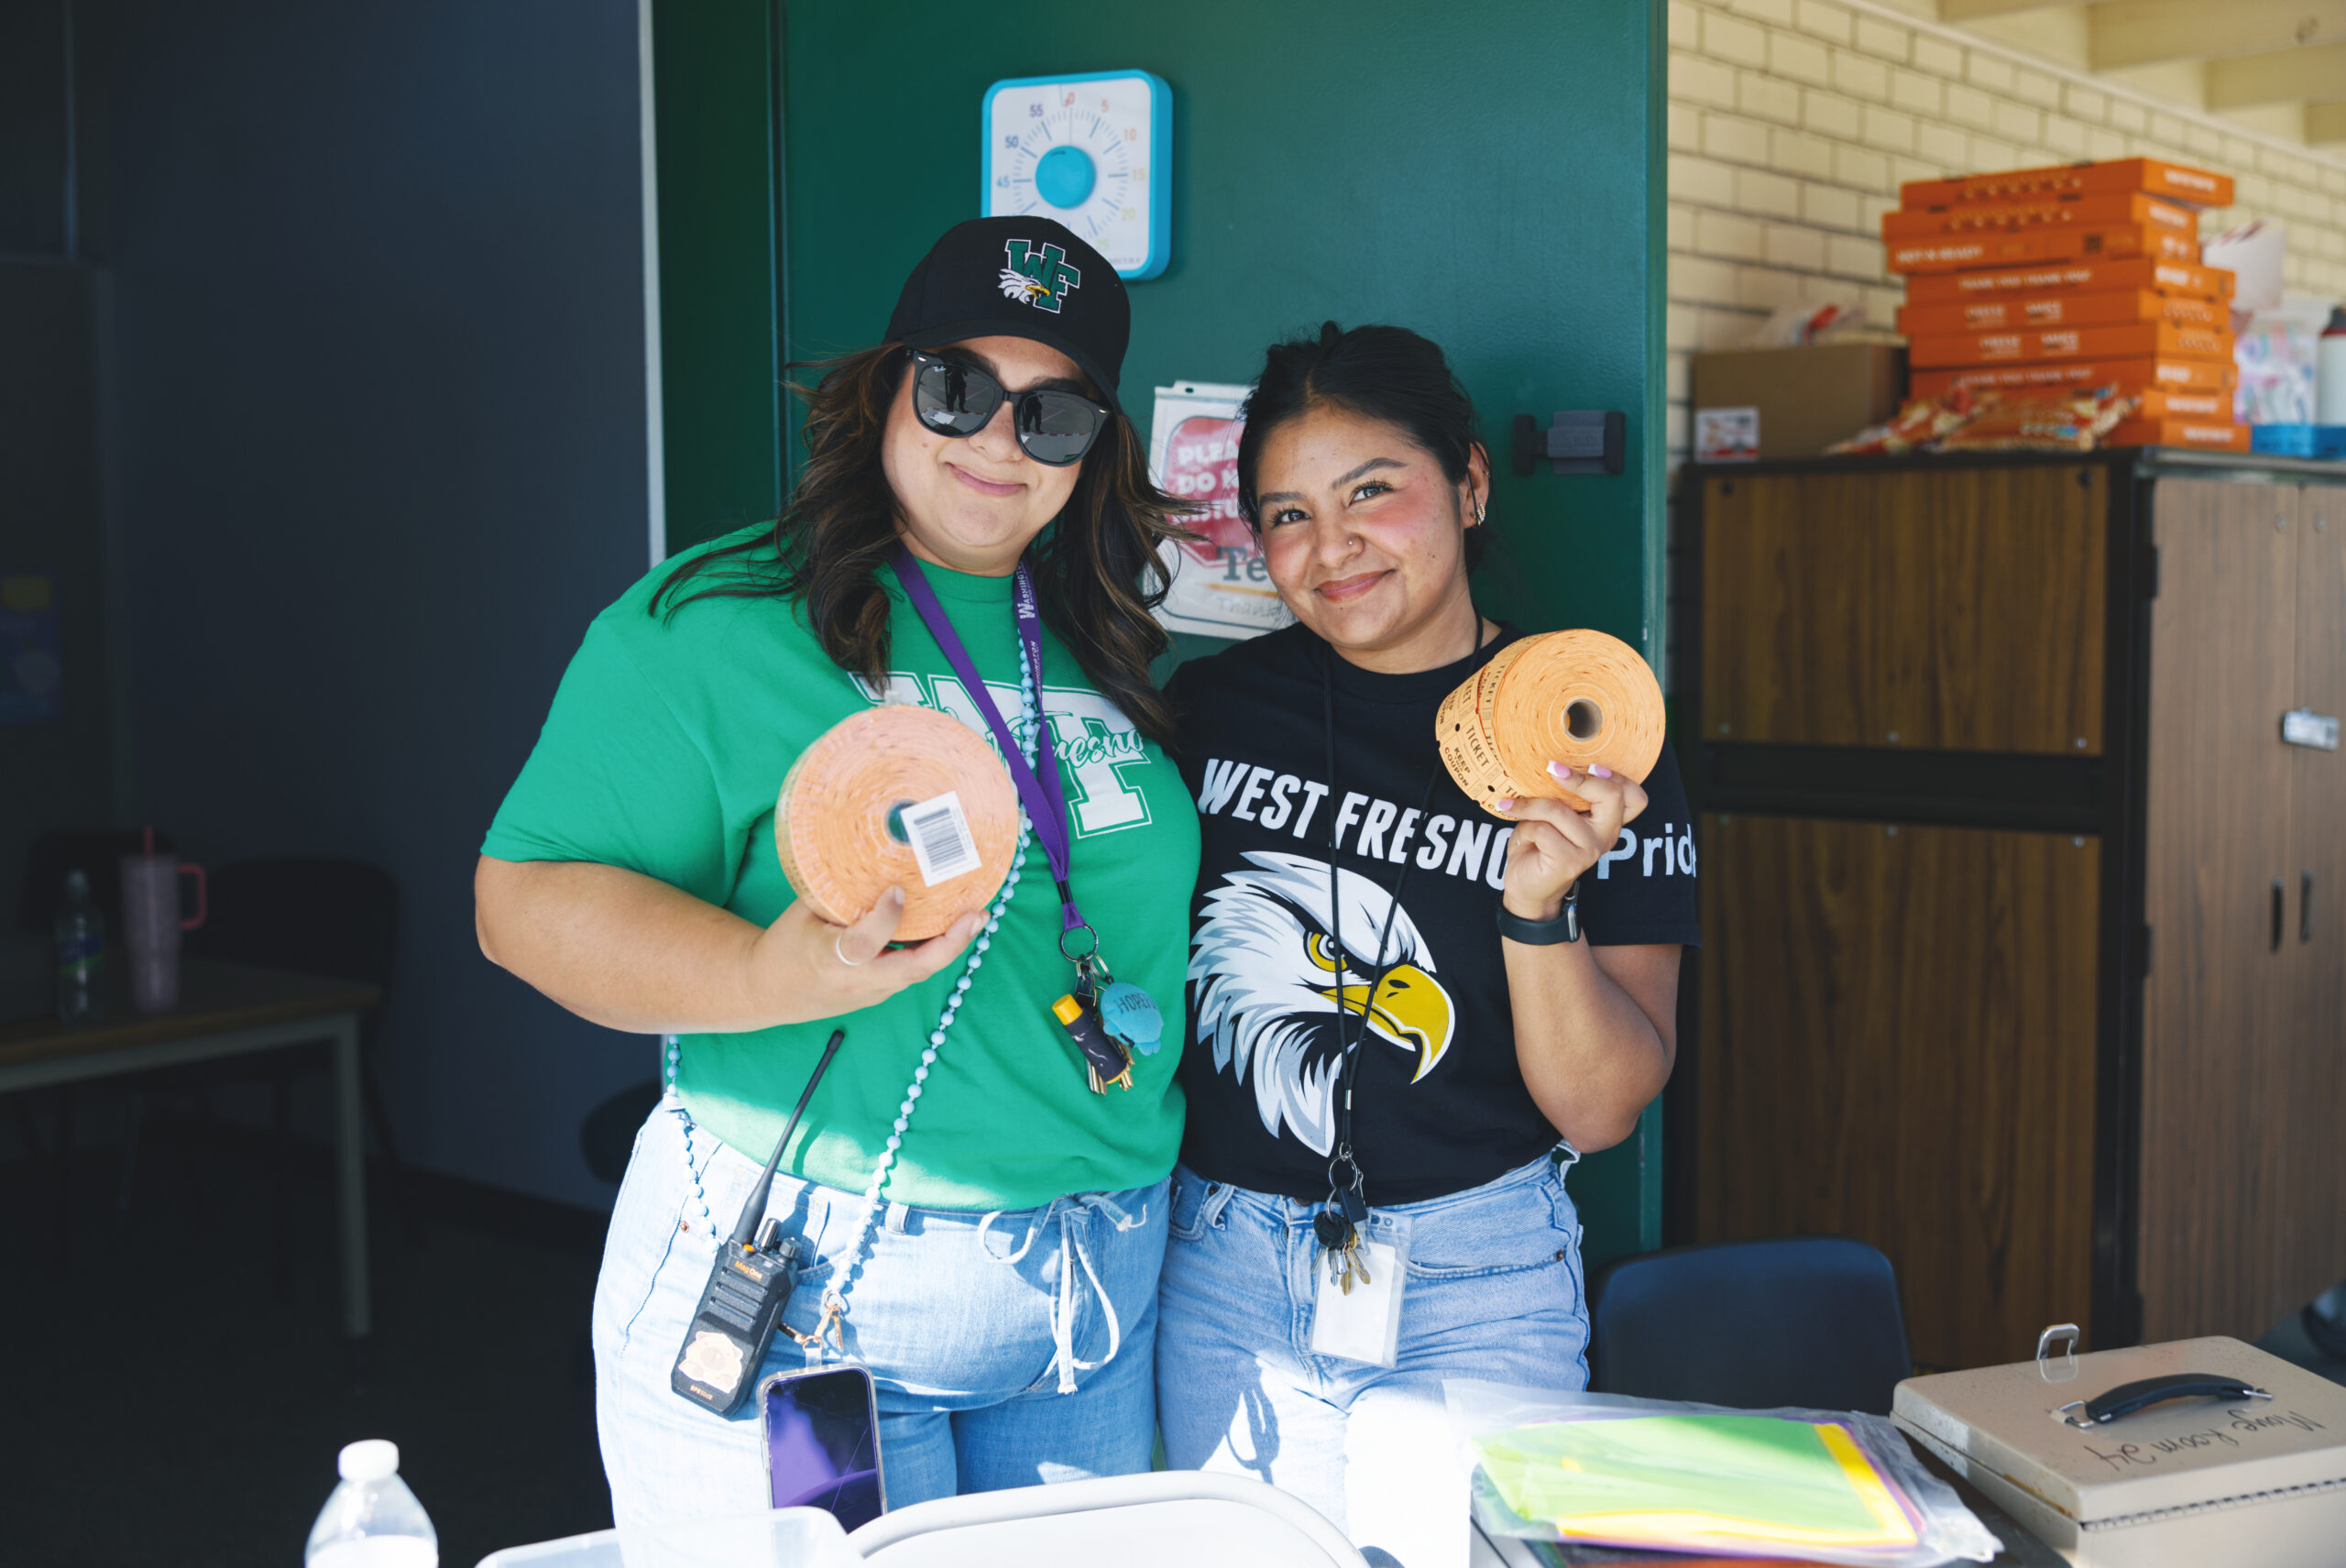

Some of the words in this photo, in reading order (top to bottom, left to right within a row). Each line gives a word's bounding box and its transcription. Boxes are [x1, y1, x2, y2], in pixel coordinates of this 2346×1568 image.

[1030, 104, 1044, 117] 55
[1102, 99, 1109, 112] 5
[1005, 136, 1019, 148] 50
[1124, 128, 1137, 141] 10
[996, 175, 1011, 189] 45
[1133, 168, 1145, 181] 15
[1121, 207, 1136, 221] 20
[1178, 471, 1217, 495] DO
[1465, 725, 1490, 767] TICKET
[1444, 746, 1469, 787] COUPON
[1453, 747, 1472, 774] KEEP
[1198, 758, 1330, 839] WEST
[1334, 791, 1513, 893] FRESNO
[1596, 822, 1697, 880] Prid
[2151, 1426, 2239, 1454] Room
[2083, 1443, 2157, 1472] 24
